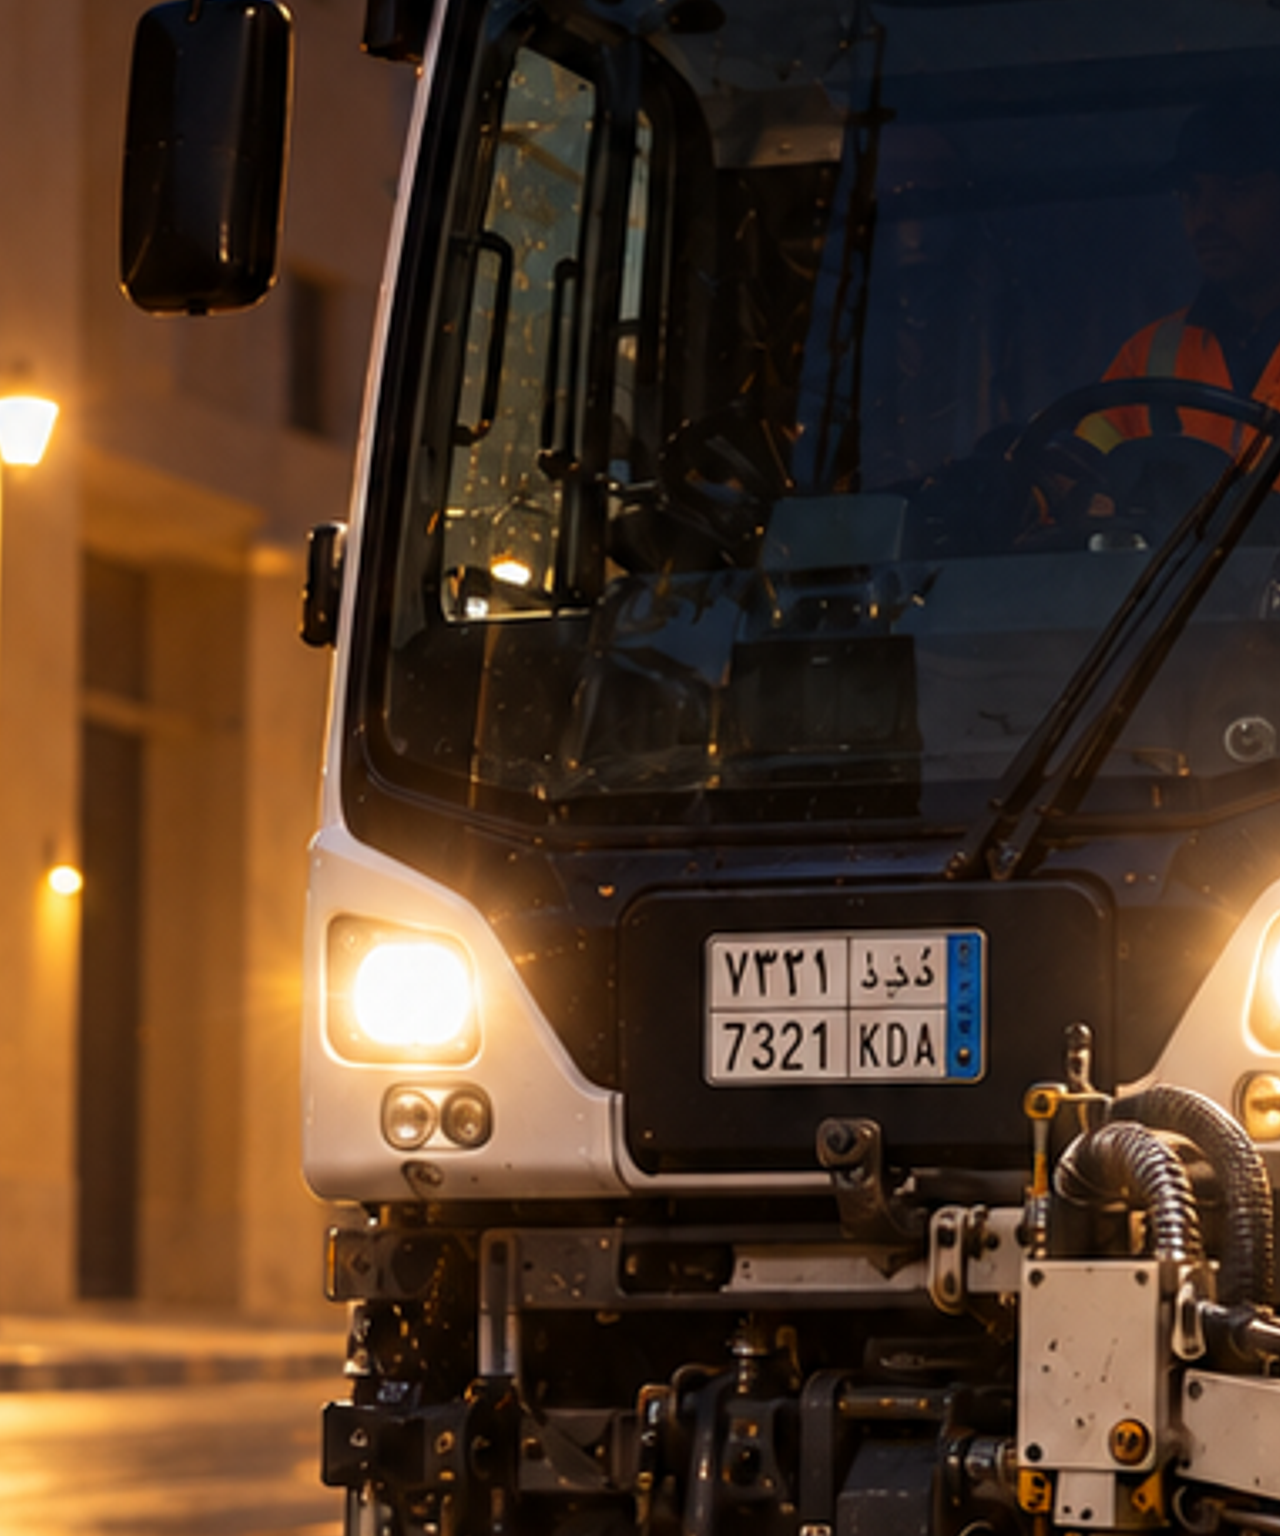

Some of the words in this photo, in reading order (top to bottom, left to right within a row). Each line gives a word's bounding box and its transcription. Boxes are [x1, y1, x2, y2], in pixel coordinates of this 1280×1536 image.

[724, 948, 828, 997] ٧٣٢١
[723, 1020, 828, 1072] 7321
[858, 1021, 937, 1068] KDA
